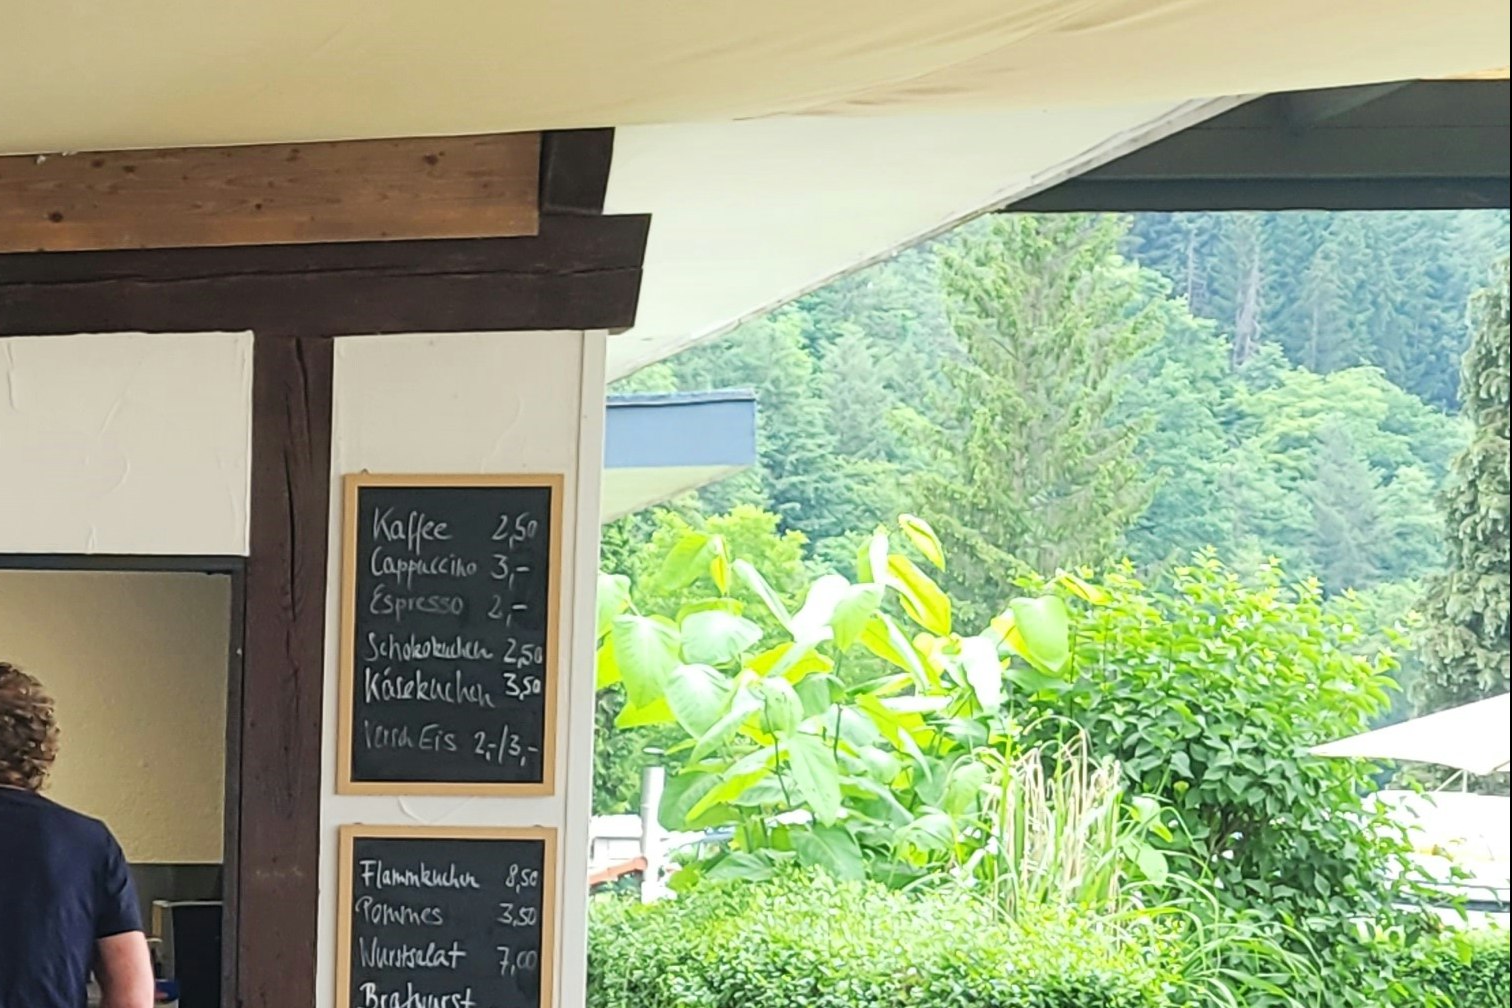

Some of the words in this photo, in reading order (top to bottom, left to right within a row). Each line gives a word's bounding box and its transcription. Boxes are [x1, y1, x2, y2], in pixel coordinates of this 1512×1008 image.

[373, 507, 453, 555] Kaffee
[491, 512, 537, 549] 2,50
[370, 546, 477, 590] Cappuccino
[490, 554, 530, 590] 3,-
[369, 583, 464, 622] Espresso
[365, 632, 494, 662] Schokokuchen
[503, 637, 543, 669] 2,50
[364, 666, 496, 708] Käsekuchen
[502, 672, 541, 701] 3,50
[418, 723, 457, 751] Eis
[359, 859, 480, 889] Flammkuchen
[505, 864, 538, 893] 8,50
[355, 895, 444, 925] Pommes
[496, 903, 537, 927] 3,50
[359, 936, 467, 969] Wurstsalat
[496, 946, 537, 976] 7,00
